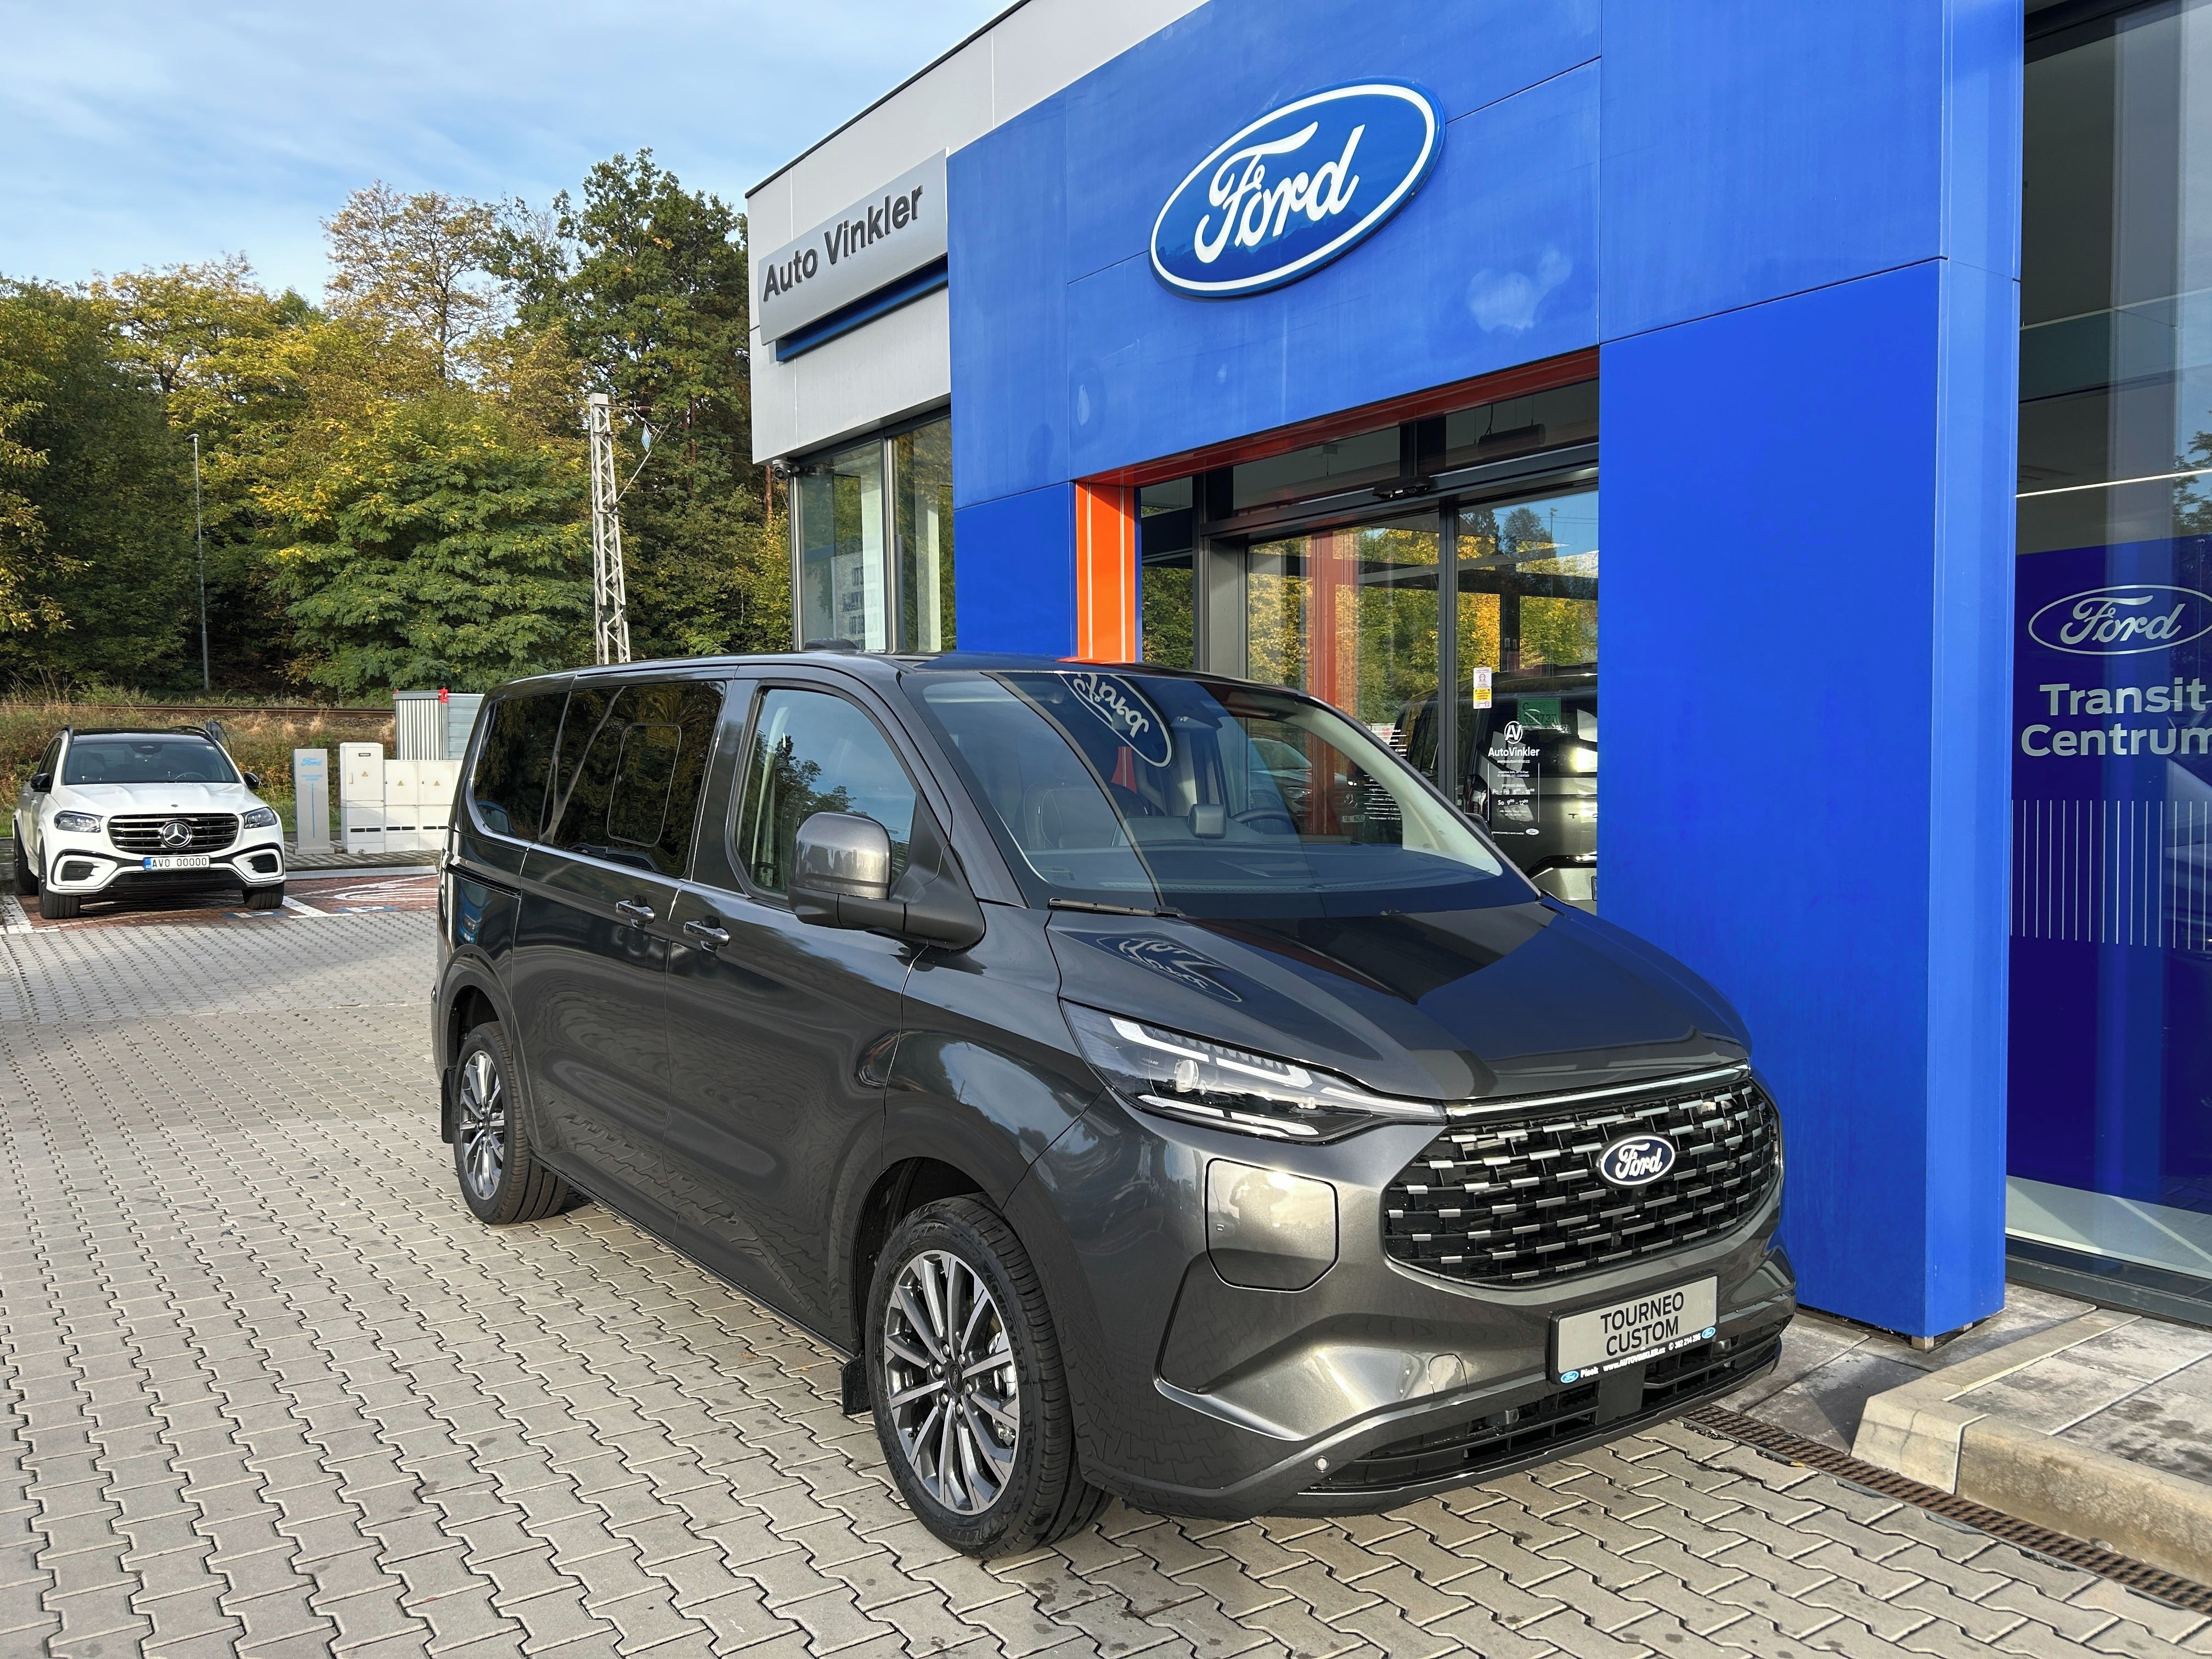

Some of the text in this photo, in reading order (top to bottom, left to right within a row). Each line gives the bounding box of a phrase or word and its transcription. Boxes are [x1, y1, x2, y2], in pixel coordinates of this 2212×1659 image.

[1194, 121, 1365, 263] Ford
[763, 185, 923, 302] Auto Vinkler
[2060, 595, 2186, 645] Ford
[2039, 677, 2207, 716] Transit
[1488, 747, 1540, 757] AutoVinkler
[1615, 1143, 1663, 1179] Ford
[1600, 1291, 1684, 1334] TOURNEO
[1606, 1316, 1679, 1356] CUSTOM
